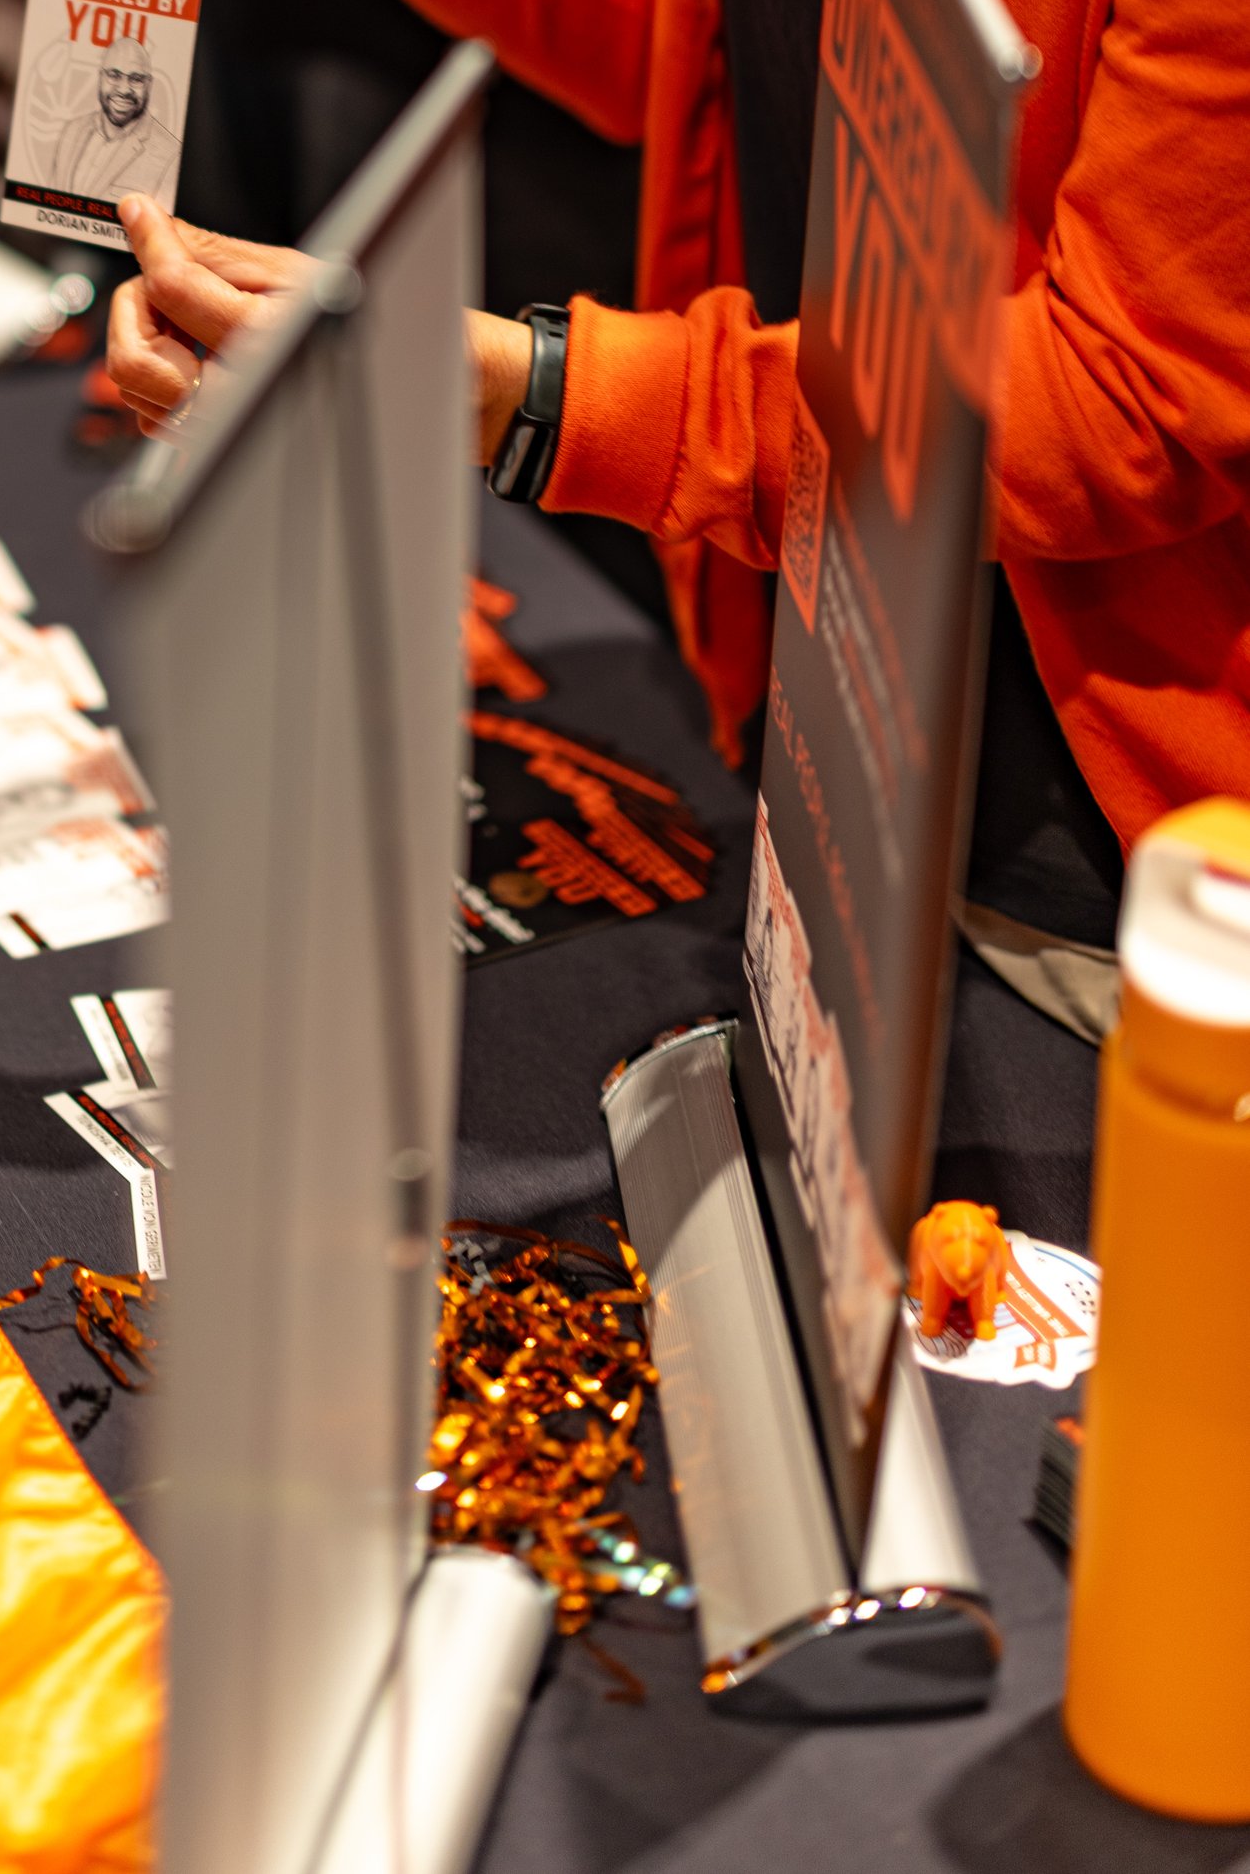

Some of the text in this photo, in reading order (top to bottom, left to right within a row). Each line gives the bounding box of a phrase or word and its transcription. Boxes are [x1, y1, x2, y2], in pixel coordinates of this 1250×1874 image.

[65, 0, 148, 48] YOU
[36, 209, 90, 233] DORIAN
[831, 112, 933, 523] YOU
